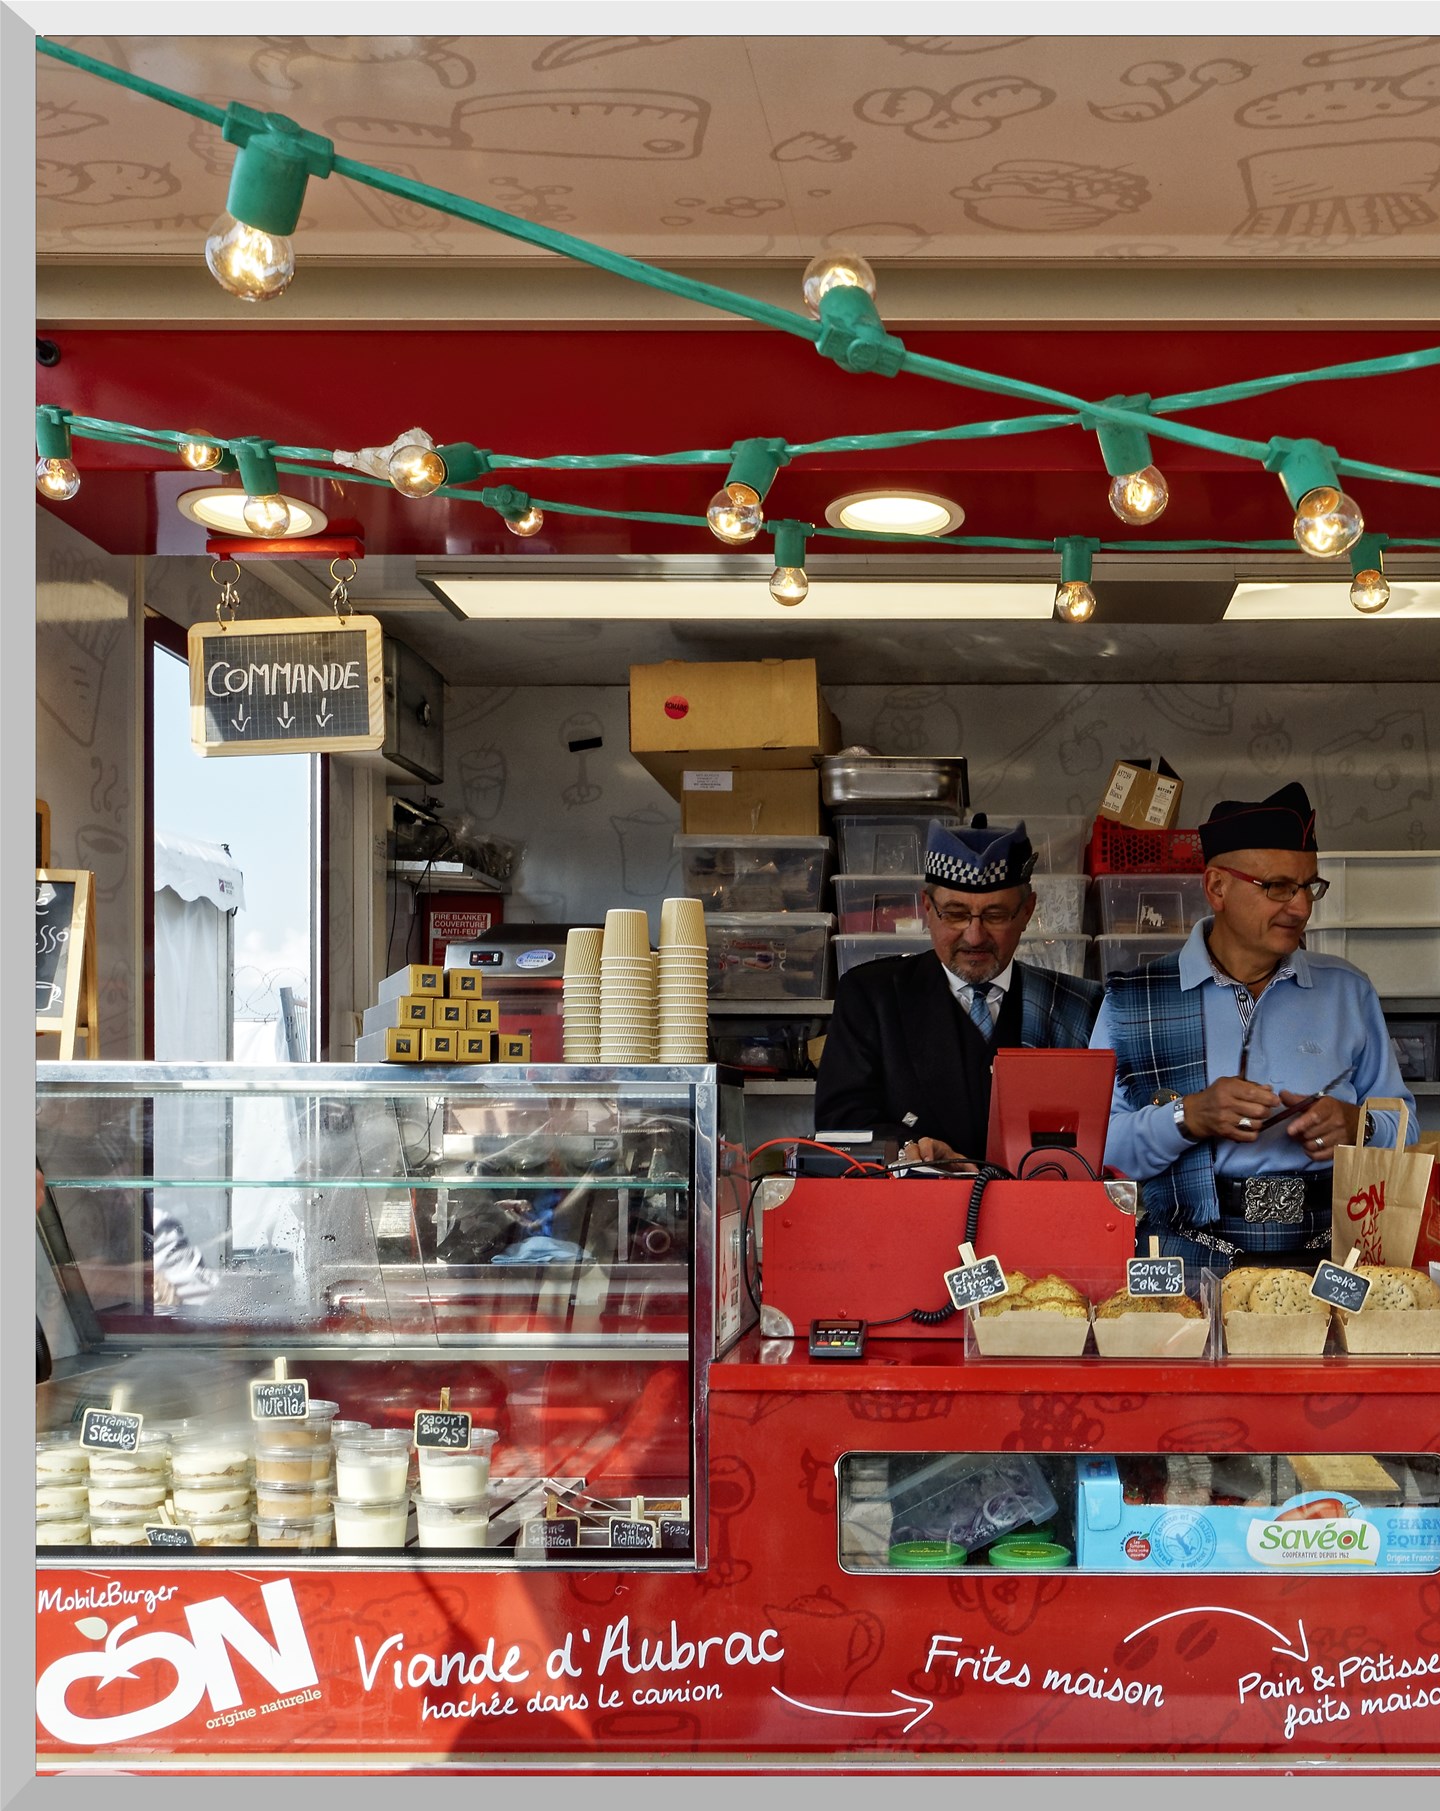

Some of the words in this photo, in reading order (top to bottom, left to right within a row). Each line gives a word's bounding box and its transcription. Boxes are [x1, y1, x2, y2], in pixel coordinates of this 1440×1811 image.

[208, 661, 360, 697] COMMANDE
[434, 920, 485, 929] COUVERTURE
[952, 1263, 989, 1285] CAKE
[1129, 1261, 1177, 1276] Carrot
[1130, 1276, 1162, 1292] Cake
[1324, 1269, 1358, 1291] Cookie
[421, 1423, 440, 1434] Bio
[1259, 1522, 1369, 1551] Savéol
[1281, 1551, 1318, 1559] COOPÉRATIVE
[1319, 1551, 1338, 1559] DEPUIS
[1386, 1553, 1410, 1563] Origine
[1411, 1553, 1435, 1562] France
[37, 1581, 179, 1614] MobileBurger
[35, 1577, 320, 1745] ON
[354, 1633, 529, 1693] Viande
[545, 1614, 786, 1680] d'Aubrac
[924, 1634, 1031, 1689] Frites
[1042, 1667, 1165, 1708] maison
[421, 1692, 519, 1722] hachée
[525, 1687, 590, 1713] dans
[598, 1684, 624, 1709] le
[631, 1682, 723, 1706] camion
[1238, 1671, 1304, 1705] Pain
[205, 1706, 257, 1730] origine
[260, 1687, 323, 1715] naturelle
[1283, 1694, 1351, 1740] faits
